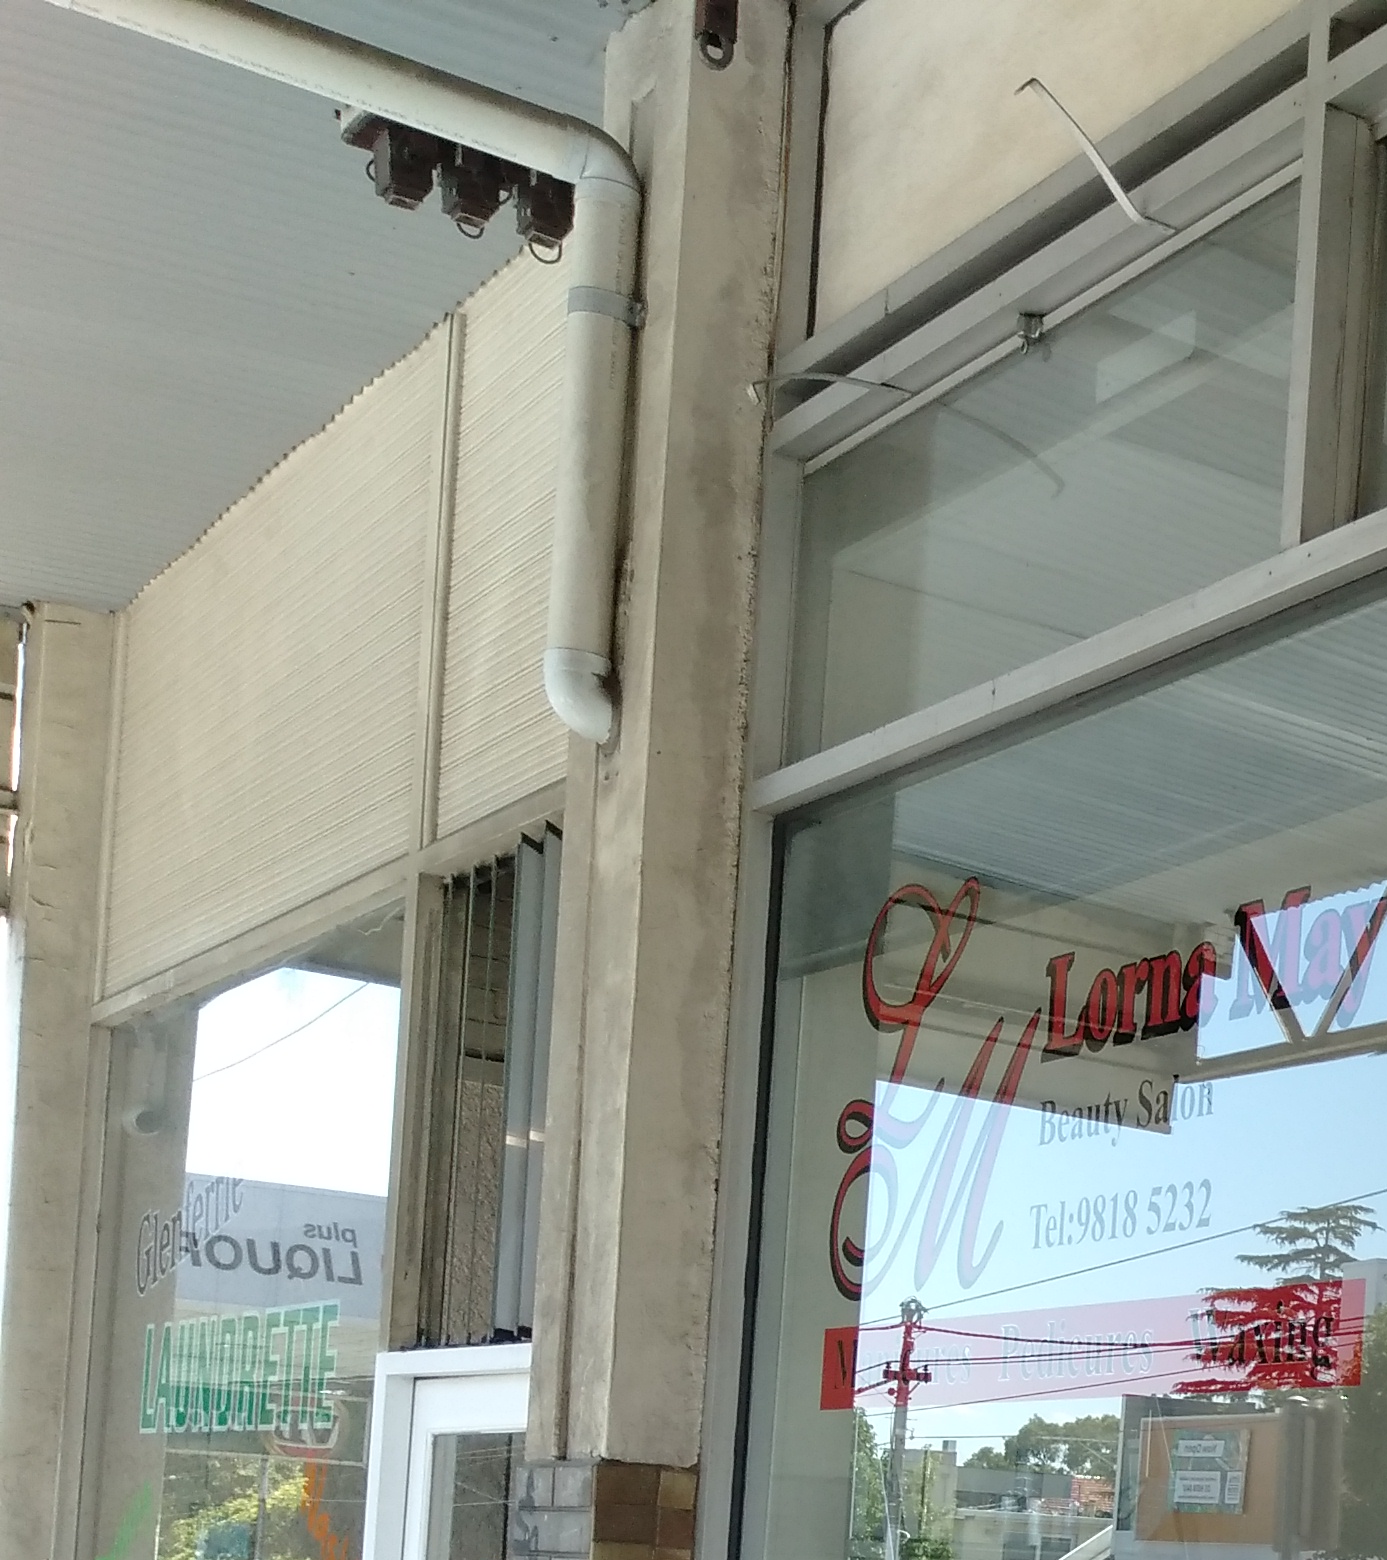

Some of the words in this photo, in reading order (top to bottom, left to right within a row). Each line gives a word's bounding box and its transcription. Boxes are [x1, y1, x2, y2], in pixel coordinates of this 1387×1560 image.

[1041, 941, 1218, 1062] Lorna
[1038, 1092, 1129, 1147] Beauty
[1135, 1074, 1215, 1126] Salon
[136, 1177, 245, 1297] Glenferrie
[1029, 1185, 1138, 1251] Tel:9818
[1146, 1178, 1213, 1237] 5232
[139, 1299, 341, 1434] LAUNDRETTE
[999, 1320, 1154, 1383] Pedicures
[1191, 1300, 1334, 1383] Waxing
